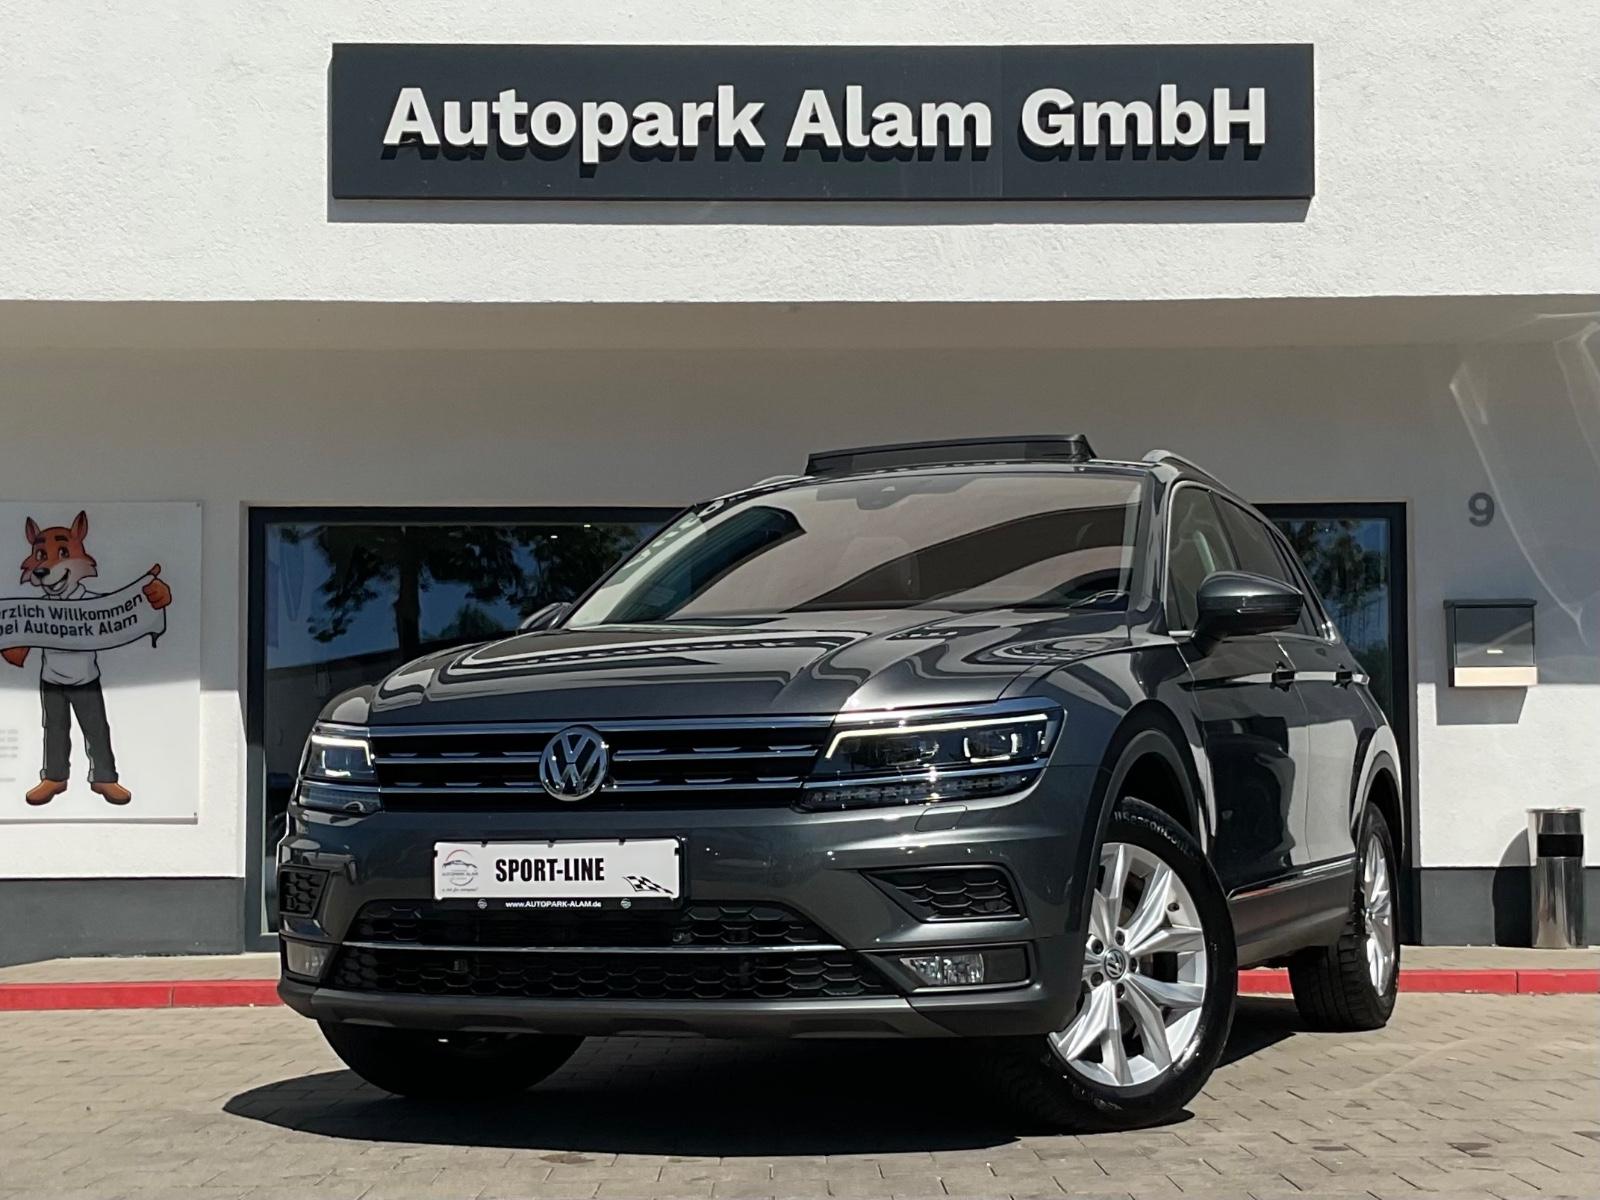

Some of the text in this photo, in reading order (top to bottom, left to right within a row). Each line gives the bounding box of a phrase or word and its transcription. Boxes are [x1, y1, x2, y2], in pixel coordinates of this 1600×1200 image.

[383, 84, 1266, 164] Autopark Alam GmbH
[1468, 492, 1495, 527] 9
[0, 593, 143, 621] rzlich Willkommen
[24, 619, 94, 638] Autopark
[98, 613, 138, 636] Alam
[542, 727, 606, 799] VW
[495, 857, 605, 882] SPORT-LINE
[505, 900, 602, 908] www.AUTOPARK-ALAM.de
